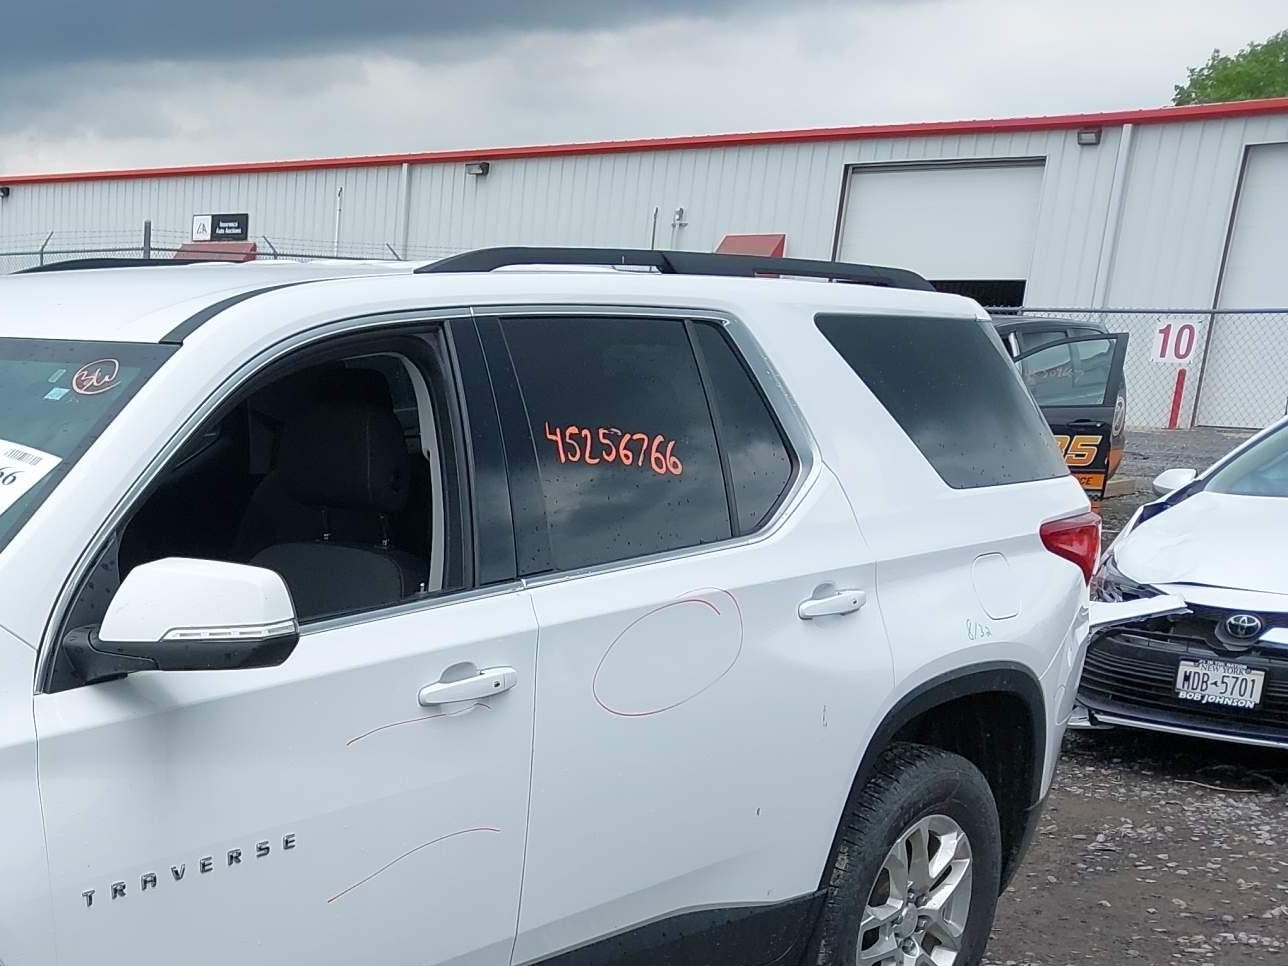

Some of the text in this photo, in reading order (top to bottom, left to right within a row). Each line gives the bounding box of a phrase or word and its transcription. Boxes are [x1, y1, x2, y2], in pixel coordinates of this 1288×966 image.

[1158, 323, 1197, 360] 10
[544, 421, 683, 476] 45256766
[1178, 691, 1255, 709] BOB JOHNSON
[1219, 675, 1256, 699] 5701
[82, 833, 297, 908] TRAVERSE
